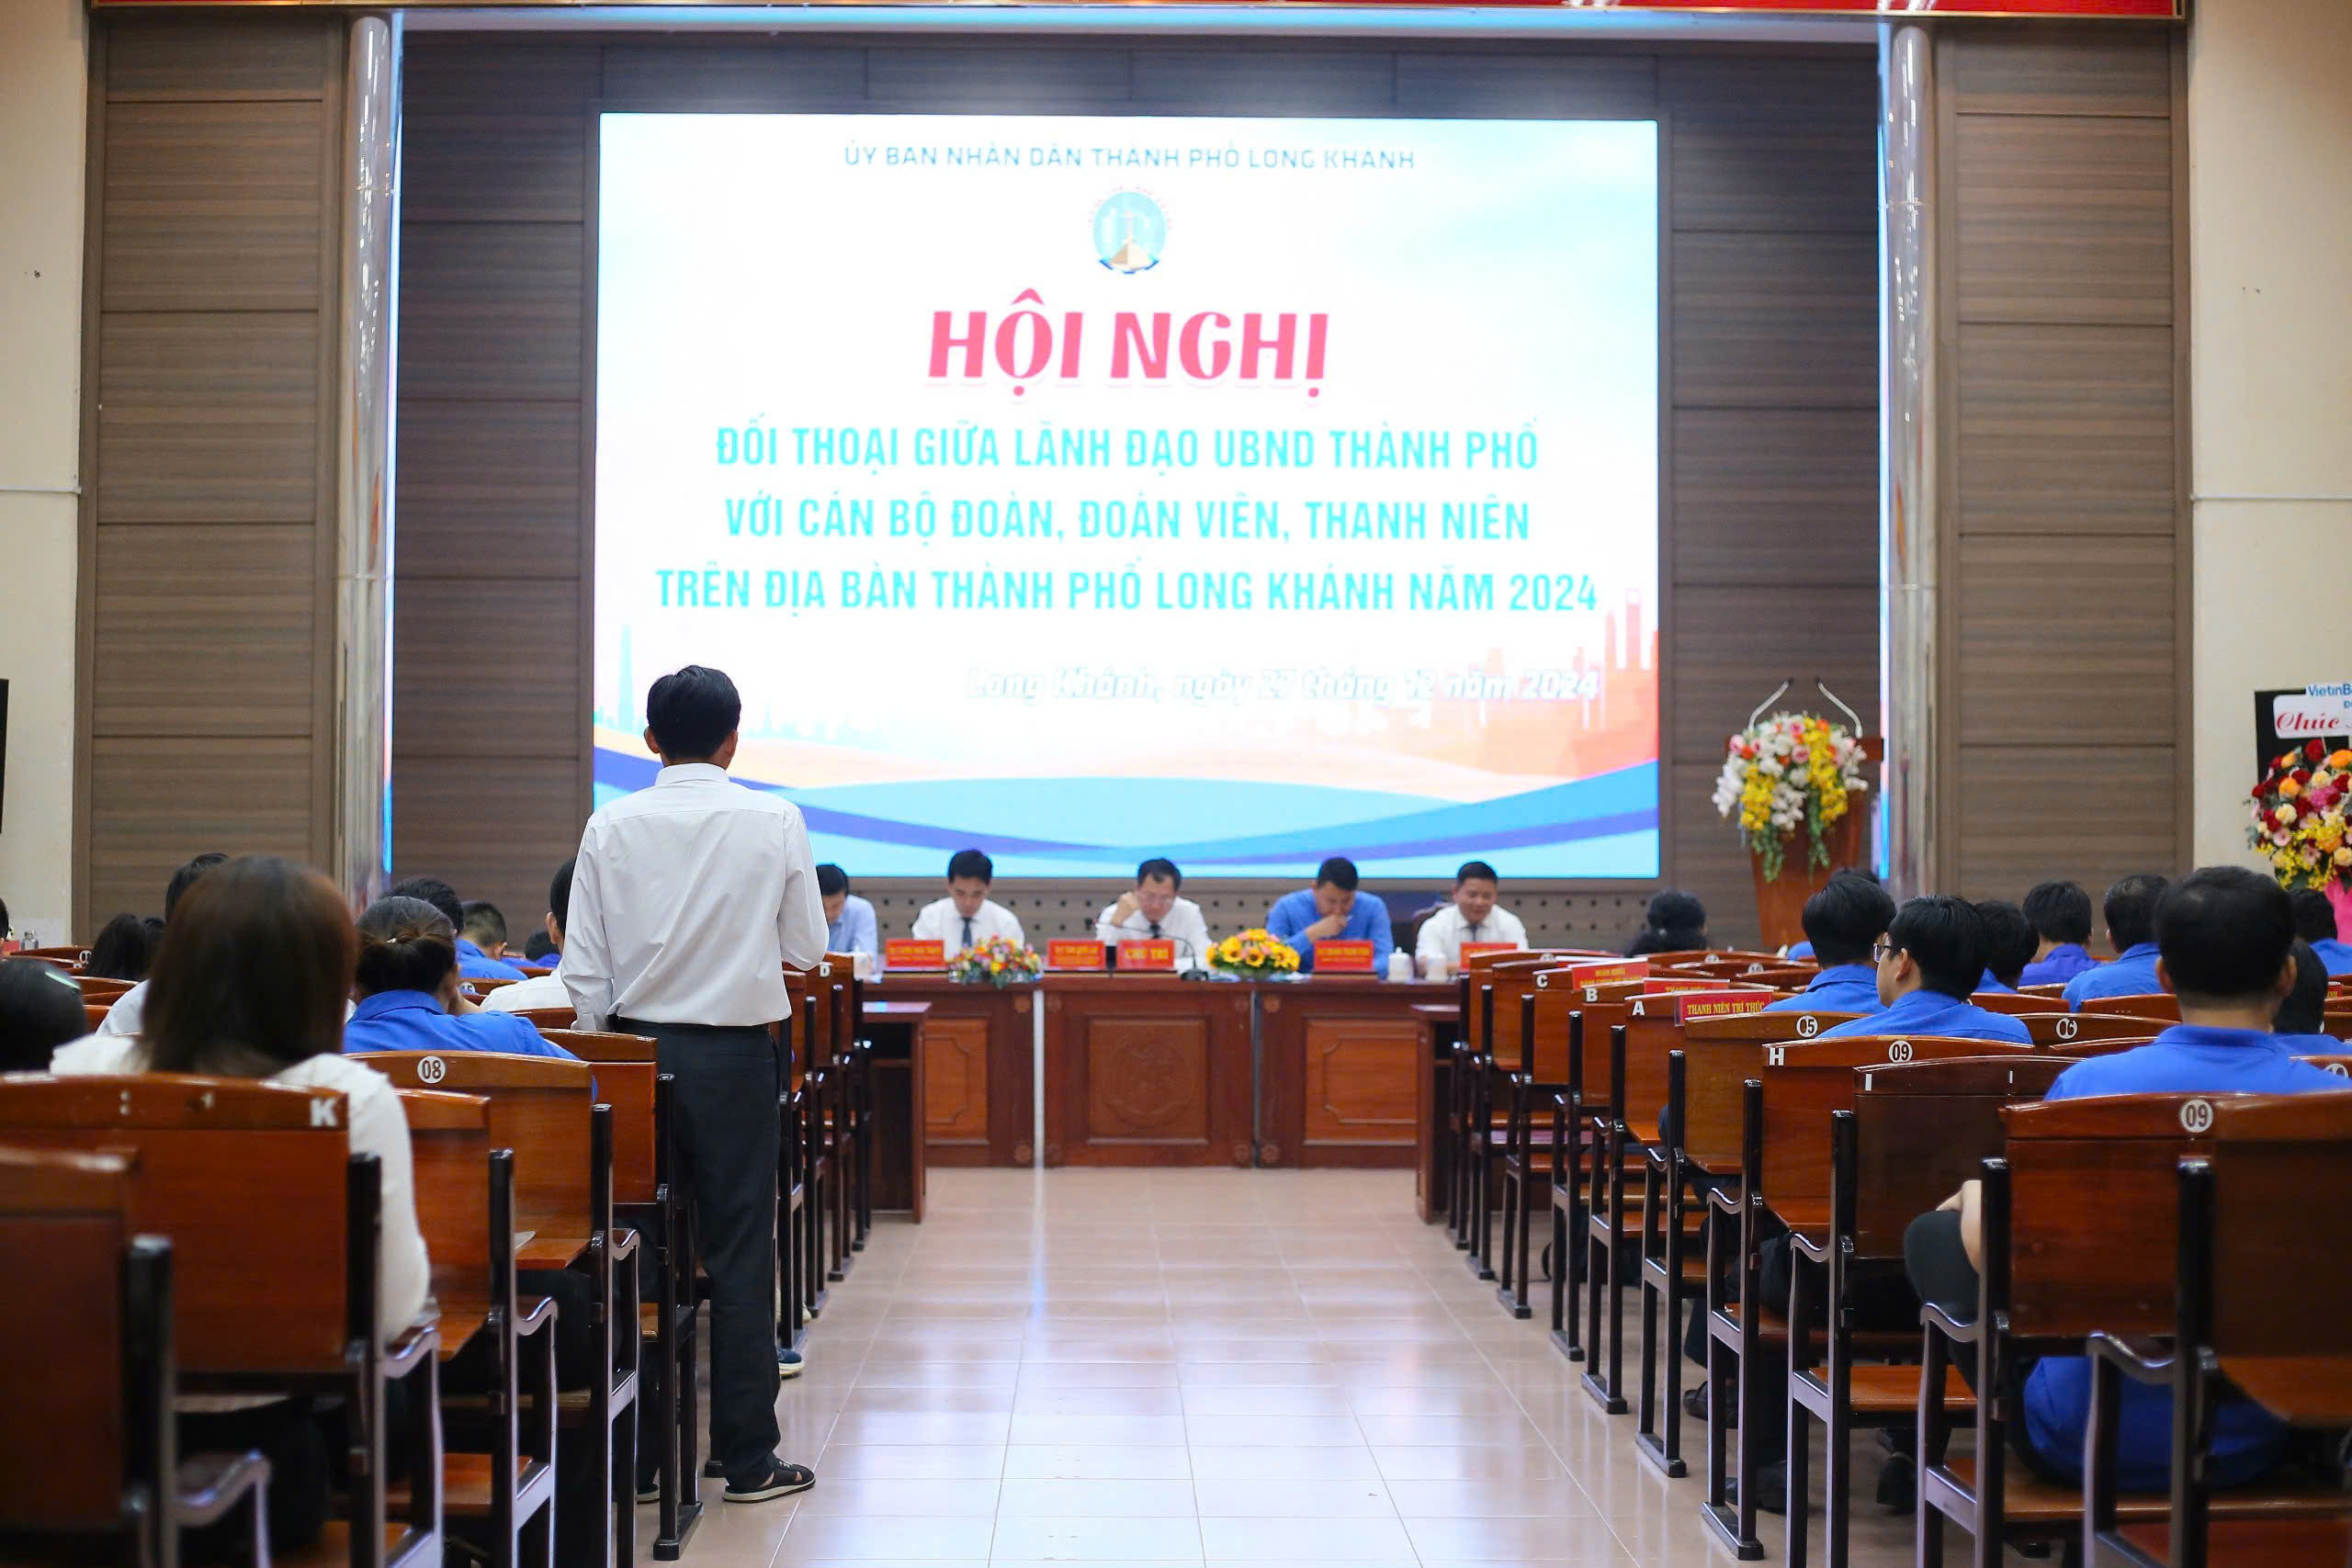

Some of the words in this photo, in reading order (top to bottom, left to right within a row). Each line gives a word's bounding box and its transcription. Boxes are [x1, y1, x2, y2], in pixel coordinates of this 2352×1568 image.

[886, 146, 938, 166] BAN
[1249, 148, 1317, 169] LONG
[929, 288, 1083, 397] HỘI
[1110, 311, 1329, 398] NGHỊ
[715, 411, 778, 467] ĐỐI
[790, 425, 899, 477] THOẠI
[912, 418, 1001, 468] GIỮA
[1013, 420, 1111, 468] LÃNH
[1124, 428, 1199, 478] ĐẠO
[1214, 425, 1316, 469] UBND
[1328, 421, 1452, 470] THÀNH
[1464, 416, 1539, 471] PHỐ
[724, 489, 784, 537] VỚI
[797, 490, 876, 538] CÁN
[888, 490, 937, 548] BỘ
[950, 490, 1066, 543] ĐOÀN,
[1078, 491, 1182, 540] ĐOÀN
[1194, 491, 1291, 545] VIÊN,
[1304, 499, 1427, 541] THANH
[1441, 492, 1530, 541] NIÊN
[653, 559, 751, 609] TRÊN
[763, 568, 827, 618] ĐỊA
[840, 561, 918, 611] BÀN
[930, 561, 1055, 611] THÀNH
[1067, 556, 1142, 611] PHỐ
[1156, 570, 1253, 611] LONG
[1267, 561, 1395, 611] KHÁNH
[1408, 565, 1495, 612] NĂM
[1508, 572, 1599, 613] 2024
[1521, 669, 1600, 700] 2024
[2307, 683, 2352, 697] VietinB
[1536, 974, 1548, 988] C
[1586, 987, 1599, 1002] B
[1632, 1000, 1645, 1016] A
[1687, 1004, 1712, 1015] THANH
[1713, 1001, 1730, 1014] NIÊN
[1798, 1017, 1816, 1035] 05
[1769, 1047, 1785, 1066] H
[1891, 1043, 1911, 1061] 09
[421, 1059, 442, 1080] 08
[310, 1097, 338, 1127] K
[2185, 1103, 2210, 1129] 09
